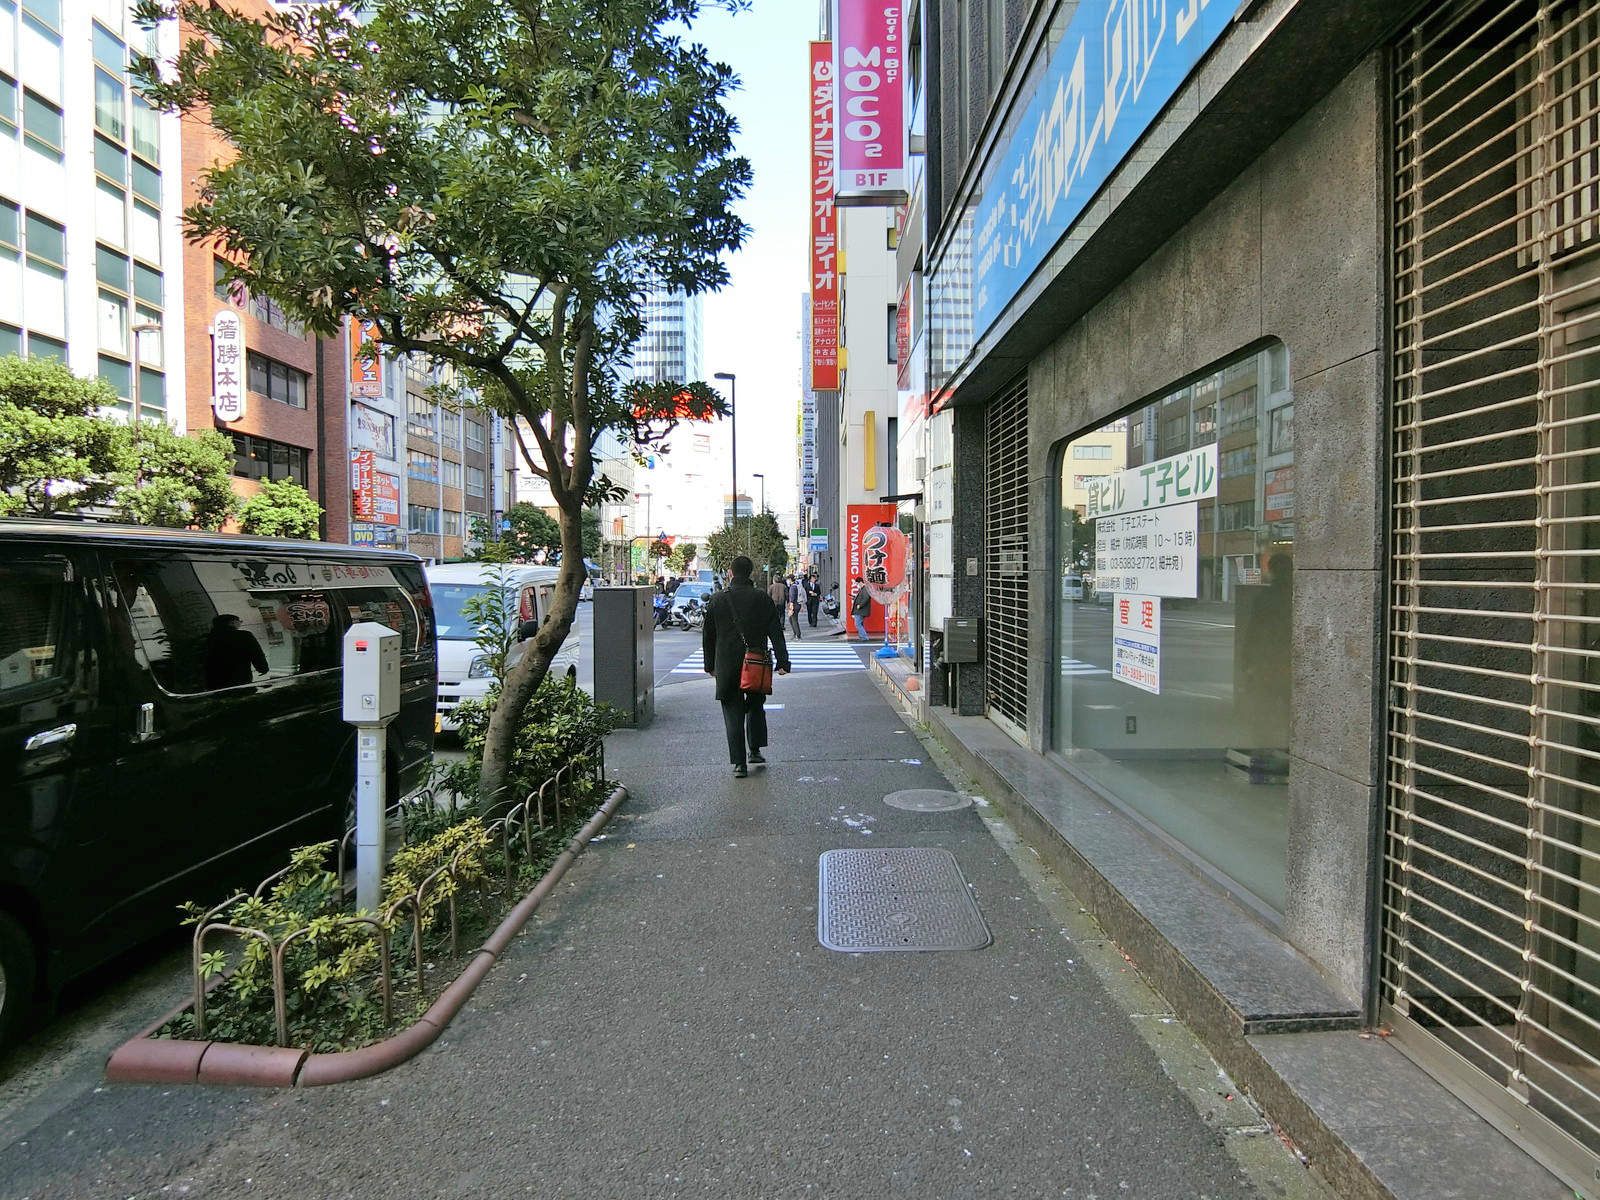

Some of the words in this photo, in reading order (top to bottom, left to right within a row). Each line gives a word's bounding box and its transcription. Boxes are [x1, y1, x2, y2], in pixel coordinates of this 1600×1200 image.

[884, 7, 899, 42] Cafe
[884, 59, 899, 84] Bar
[814, 84, 834, 290] ダイナミックオーディオ
[856, 174, 888, 187] B1F
[217, 319, 239, 412] 箸勝本店
[360, 452, 372, 515] インターネットカフェ
[1088, 477, 1125, 516] 貸ビル
[1140, 451, 1214, 507] 丁子ビル
[354, 532, 373, 541] DVD
[850, 514, 859, 575] DYNAMIC
[1097, 519, 1116, 533] 株式会社
[862, 532, 888, 585] つけ麺
[1119, 598, 1153, 629] 管理
